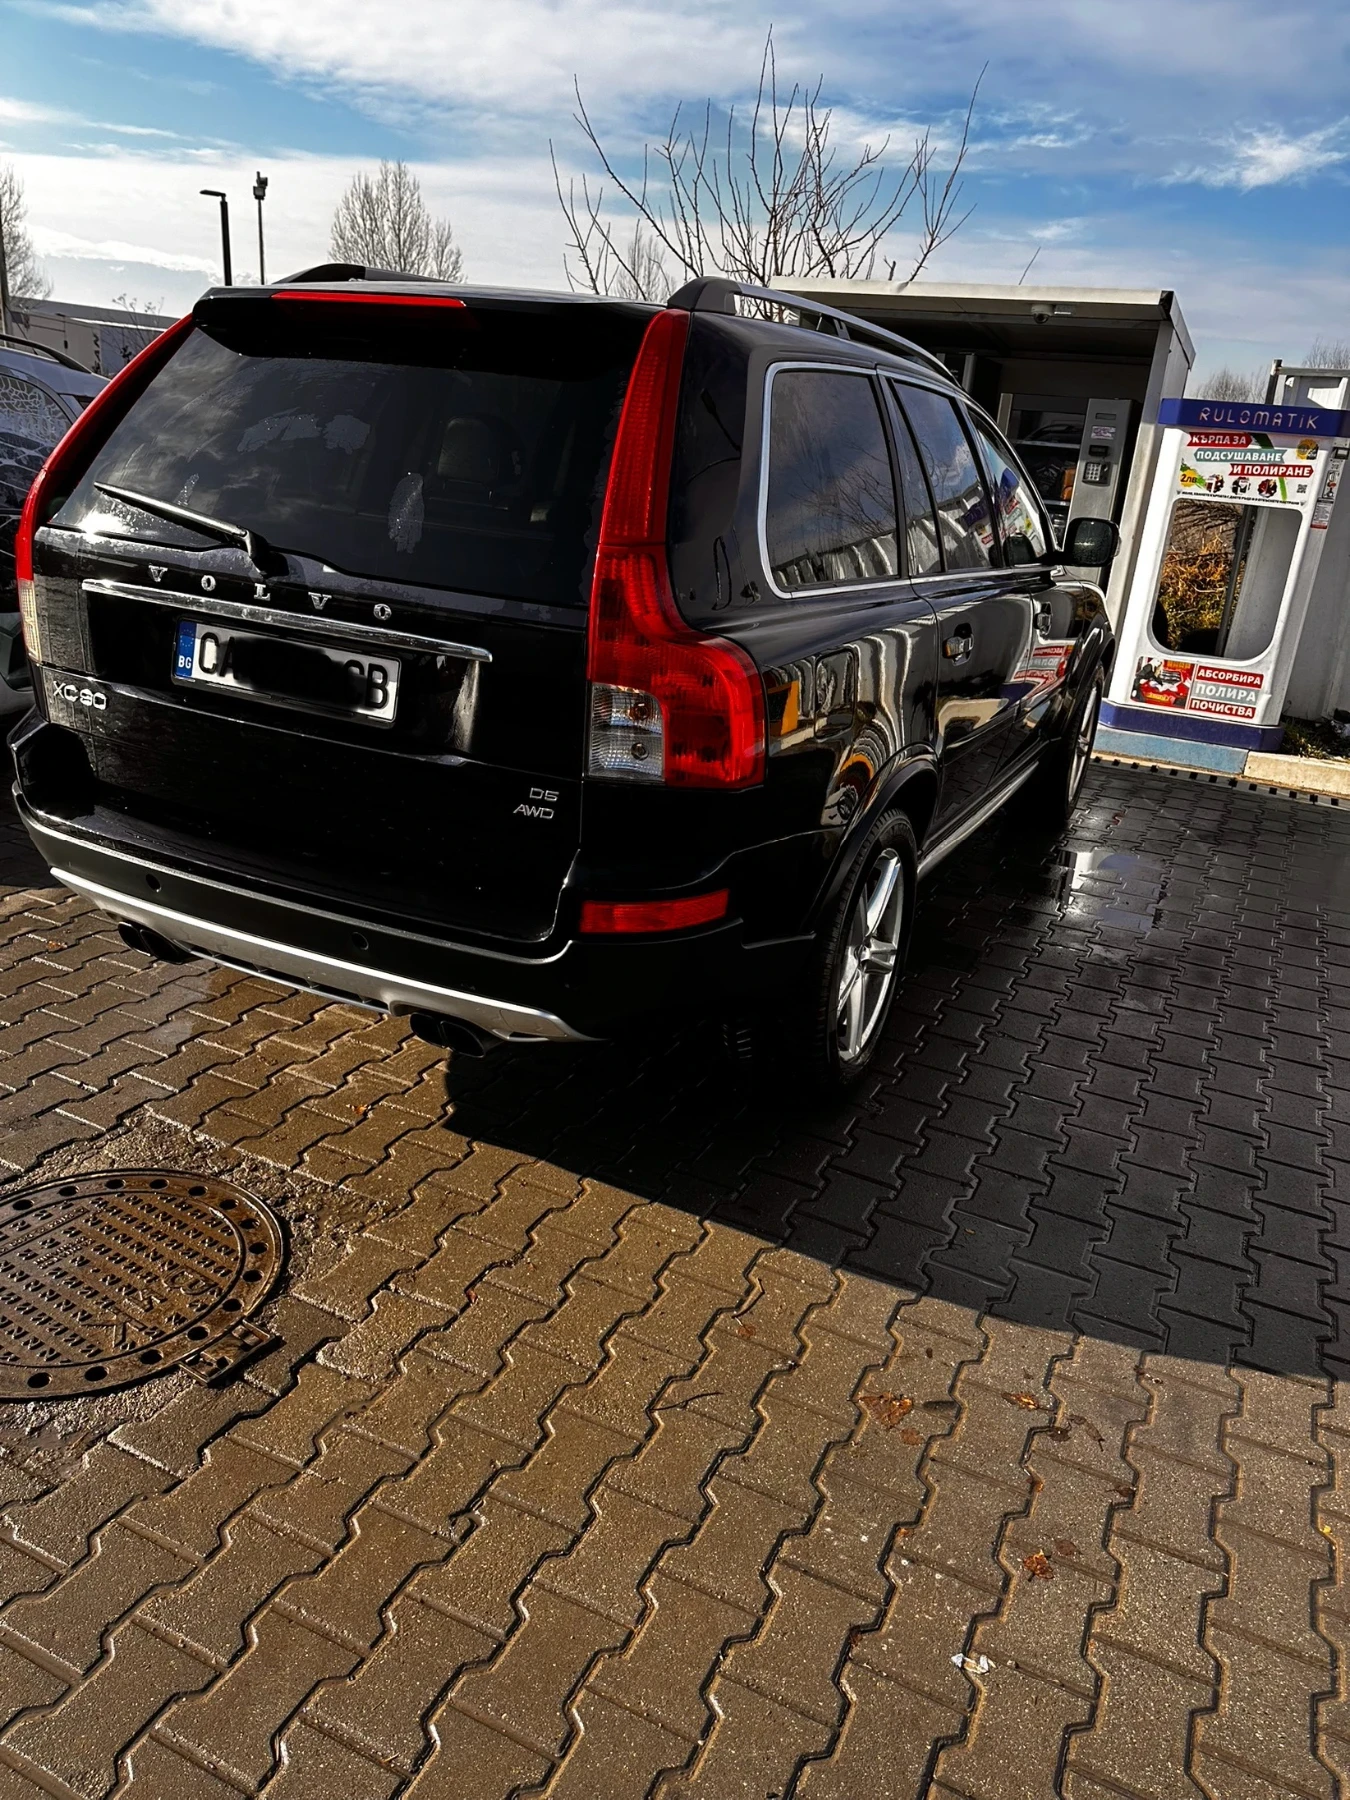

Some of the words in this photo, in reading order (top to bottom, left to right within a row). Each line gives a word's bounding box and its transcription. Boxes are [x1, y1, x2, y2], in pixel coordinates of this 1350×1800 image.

[1191, 434, 1231, 445] КЪРПА
[1232, 437, 1248, 445] ЗА
[1196, 450, 1282, 462] ПОДСУШАВАНЕ
[1232, 465, 1242, 474] И
[1243, 465, 1311, 477] ПОЛИРАНЕ
[148, 565, 393, 621] VOLVO
[177, 654, 193, 669] BG
[1198, 668, 1262, 686] АБСОРБИРА
[53, 680, 108, 711] XC90
[1194, 683, 1257, 702] ПОЛИРА
[1190, 700, 1253, 717] ПОЧИСТВА
[529, 787, 560, 802] D5
[512, 803, 554, 820] AWD
